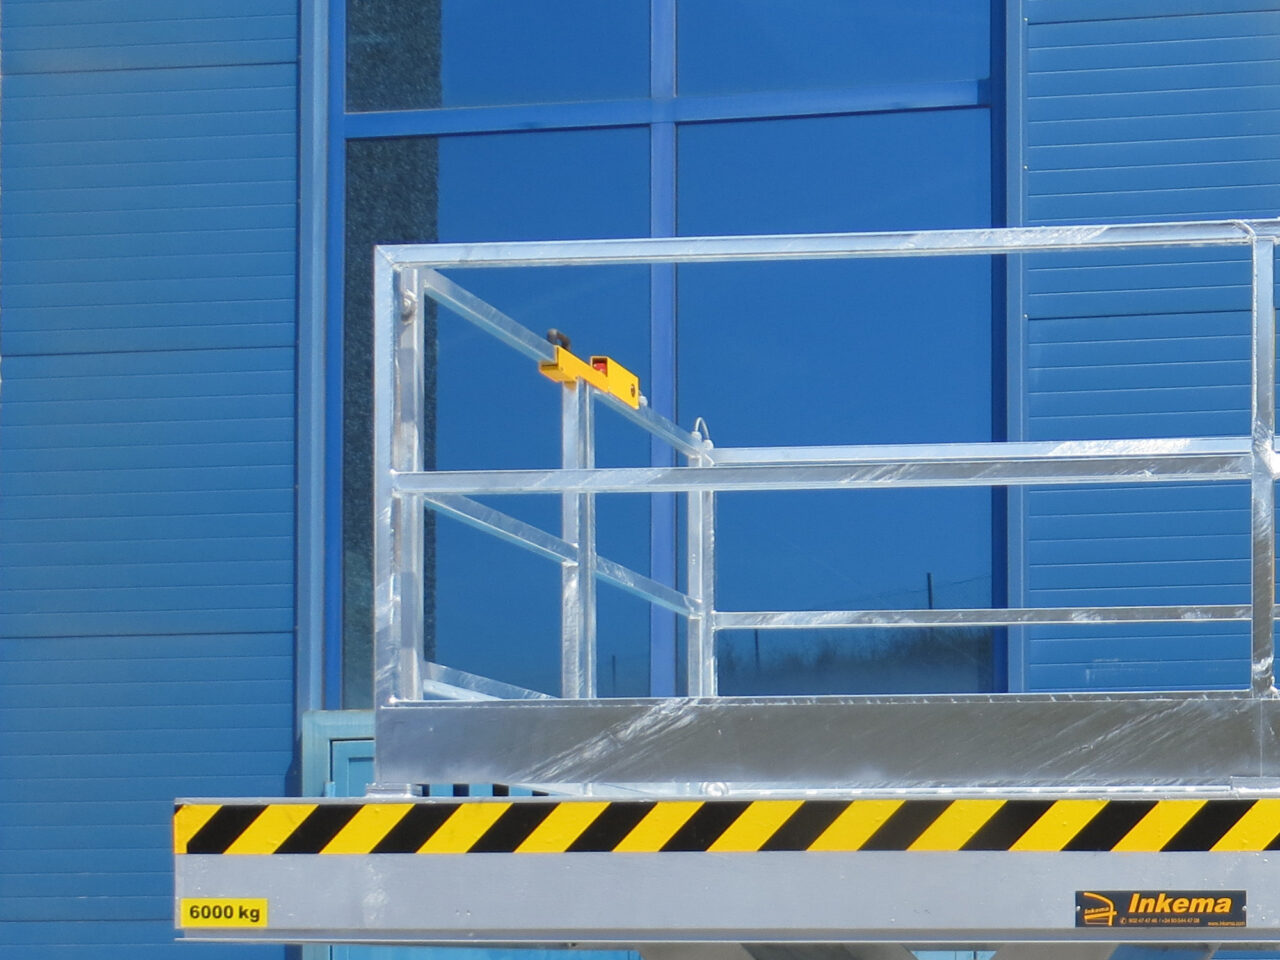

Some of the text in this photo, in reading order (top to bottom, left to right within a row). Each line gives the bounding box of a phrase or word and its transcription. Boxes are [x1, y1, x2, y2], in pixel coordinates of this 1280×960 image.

[1128, 892, 1233, 914] Inkema
[189, 905, 260, 923] 6000 kg
